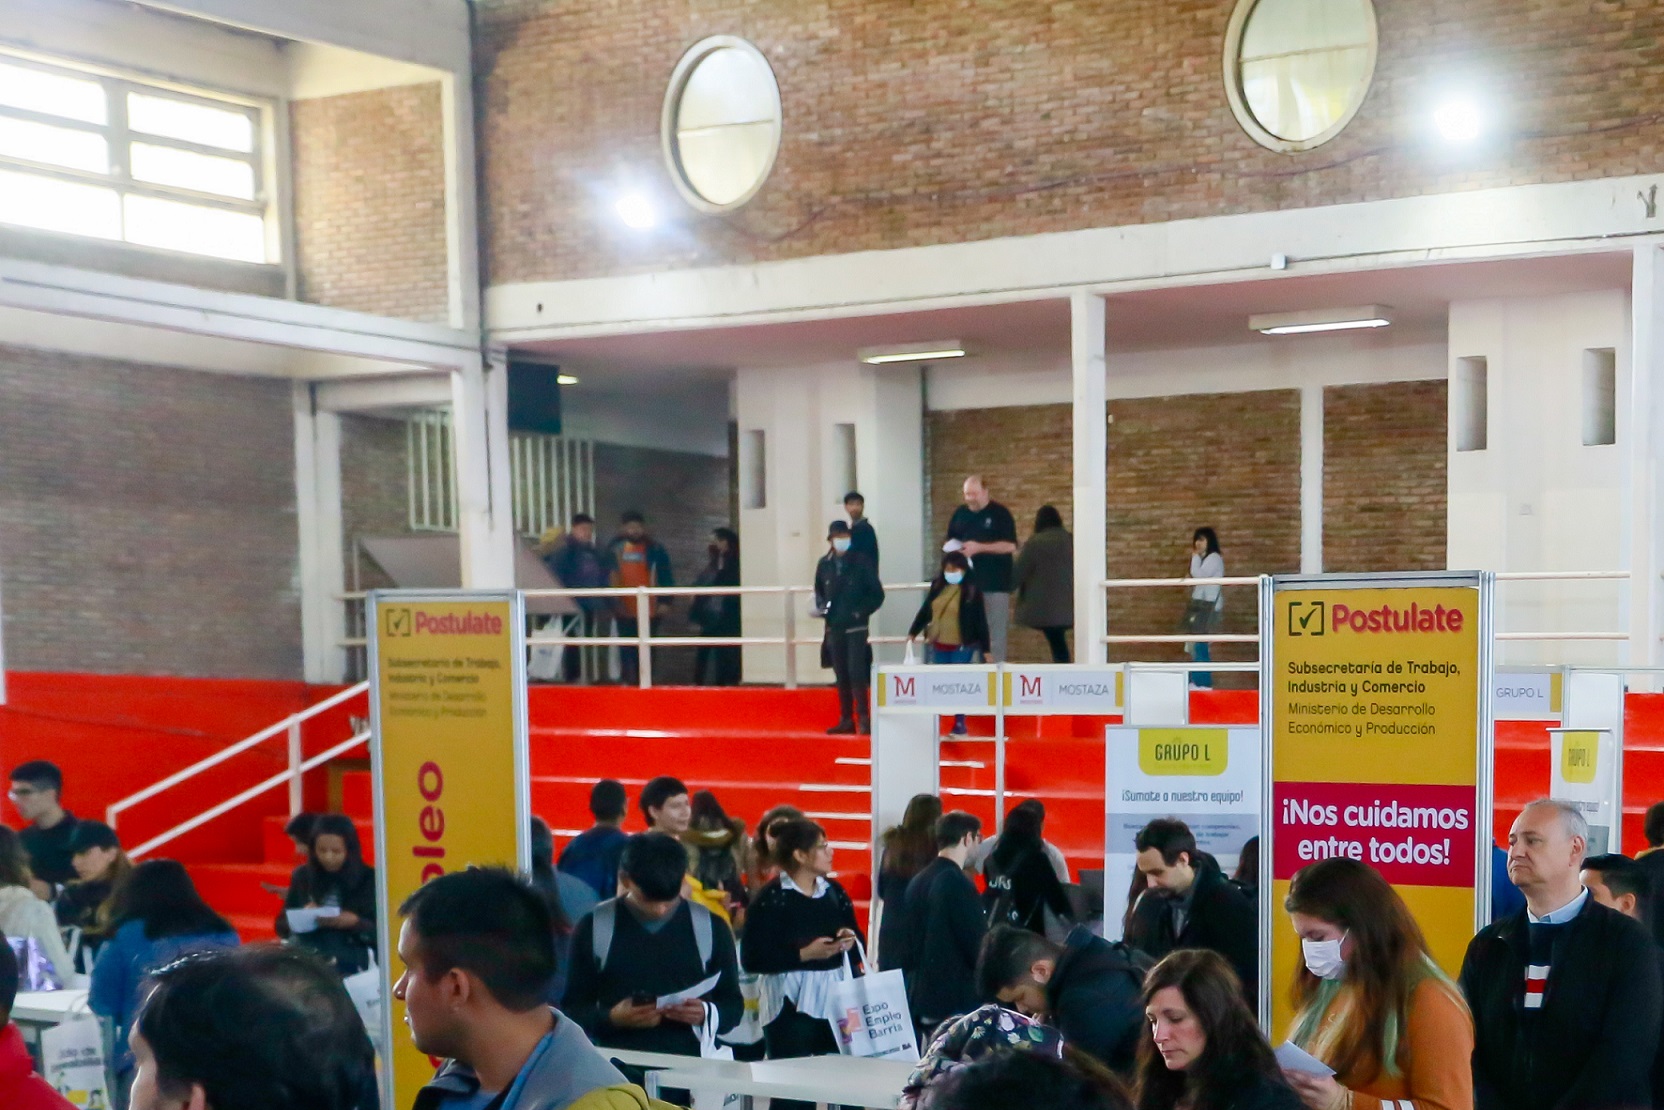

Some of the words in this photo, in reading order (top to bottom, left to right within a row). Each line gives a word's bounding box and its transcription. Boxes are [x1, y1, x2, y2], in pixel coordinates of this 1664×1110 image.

[415, 610, 503, 635] Postulate
[1332, 602, 1464, 634] Postulate
[1287, 661, 1382, 675] Subsecretaría
[1387, 661, 1403, 675] de
[1407, 661, 1461, 678] Trabajo,
[932, 684, 981, 695] MOSTAZA
[1058, 684, 1109, 697] MOSTAZA
[1288, 680, 1346, 694] Industria
[1350, 683, 1358, 697] y
[1362, 680, 1426, 694] Comercio
[1496, 687, 1534, 698] GRUPO
[1537, 687, 1544, 698] L
[1288, 702, 1349, 716] Ministerio
[1352, 702, 1367, 716] de
[1370, 702, 1436, 716] Desarrollo
[1288, 721, 1352, 734] Económico
[1355, 724, 1363, 738] y
[1366, 721, 1436, 735] Producción
[1154, 744, 1199, 762] GRUPO
[1204, 744, 1211, 761] L
[1163, 792, 1169, 803] a
[1170, 790, 1208, 803] nuestro
[1282, 798, 1339, 827] ¡Nos
[1343, 799, 1470, 830] cuidamos
[1297, 836, 1364, 862] entre
[1369, 836, 1452, 866] todos!
